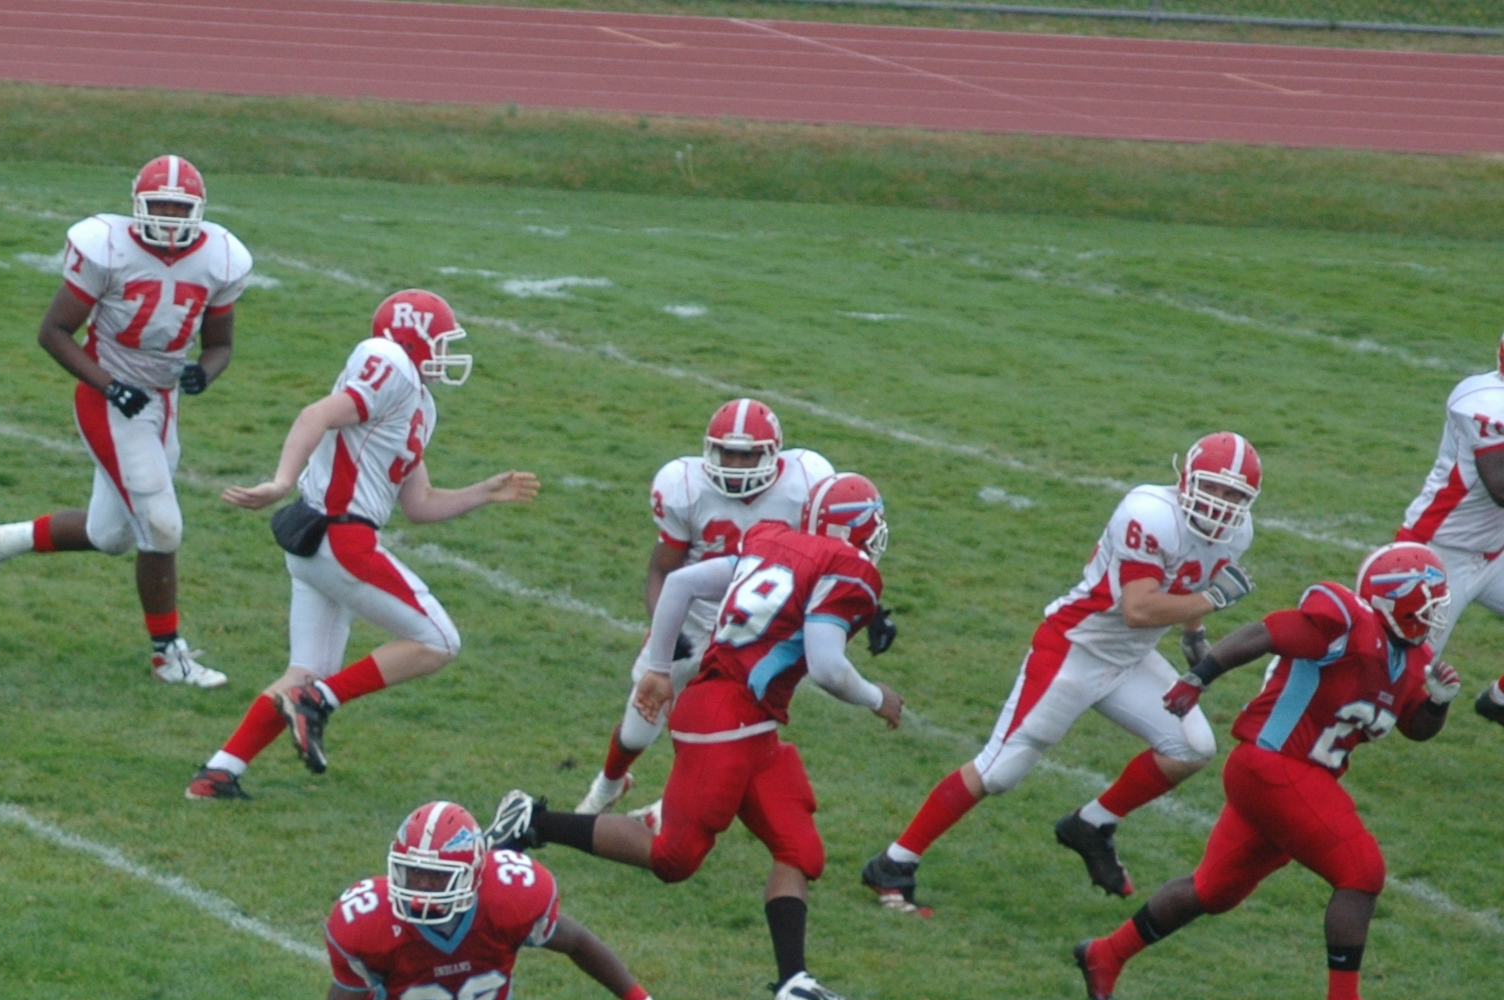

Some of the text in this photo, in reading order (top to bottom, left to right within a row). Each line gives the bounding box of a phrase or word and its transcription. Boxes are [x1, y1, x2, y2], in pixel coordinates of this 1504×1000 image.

[116, 279, 209, 353] 77
[392, 303, 434, 334] RV
[359, 355, 393, 392] 51
[493, 849, 535, 888] 32
[340, 878, 379, 923] 32
[433, 960, 472, 978] INDIANS
